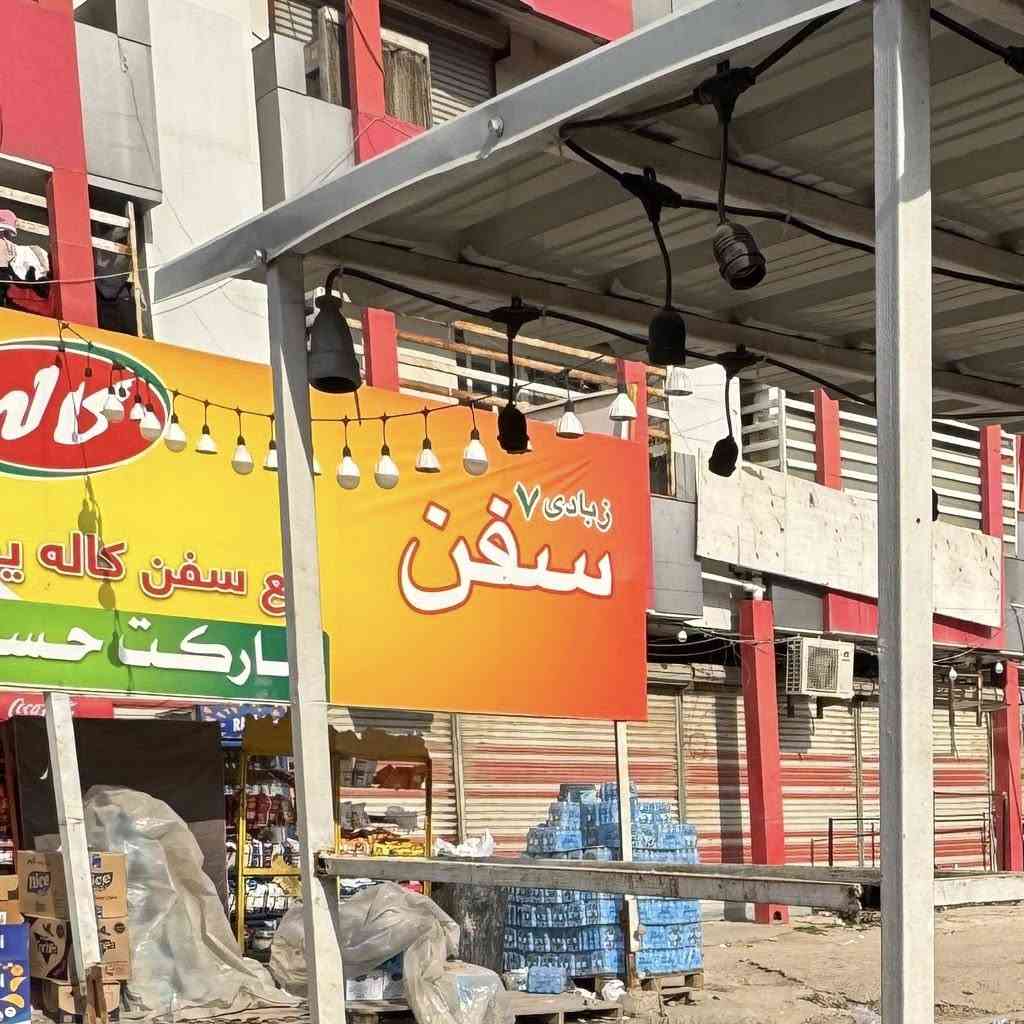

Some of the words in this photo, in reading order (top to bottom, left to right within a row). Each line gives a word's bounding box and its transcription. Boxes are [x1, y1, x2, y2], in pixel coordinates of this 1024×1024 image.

[37, 529, 127, 581] كاله
[139, 551, 248, 598] سفن
[399, 493, 613, 614] سفن
[118, 616, 289, 686] اركت
